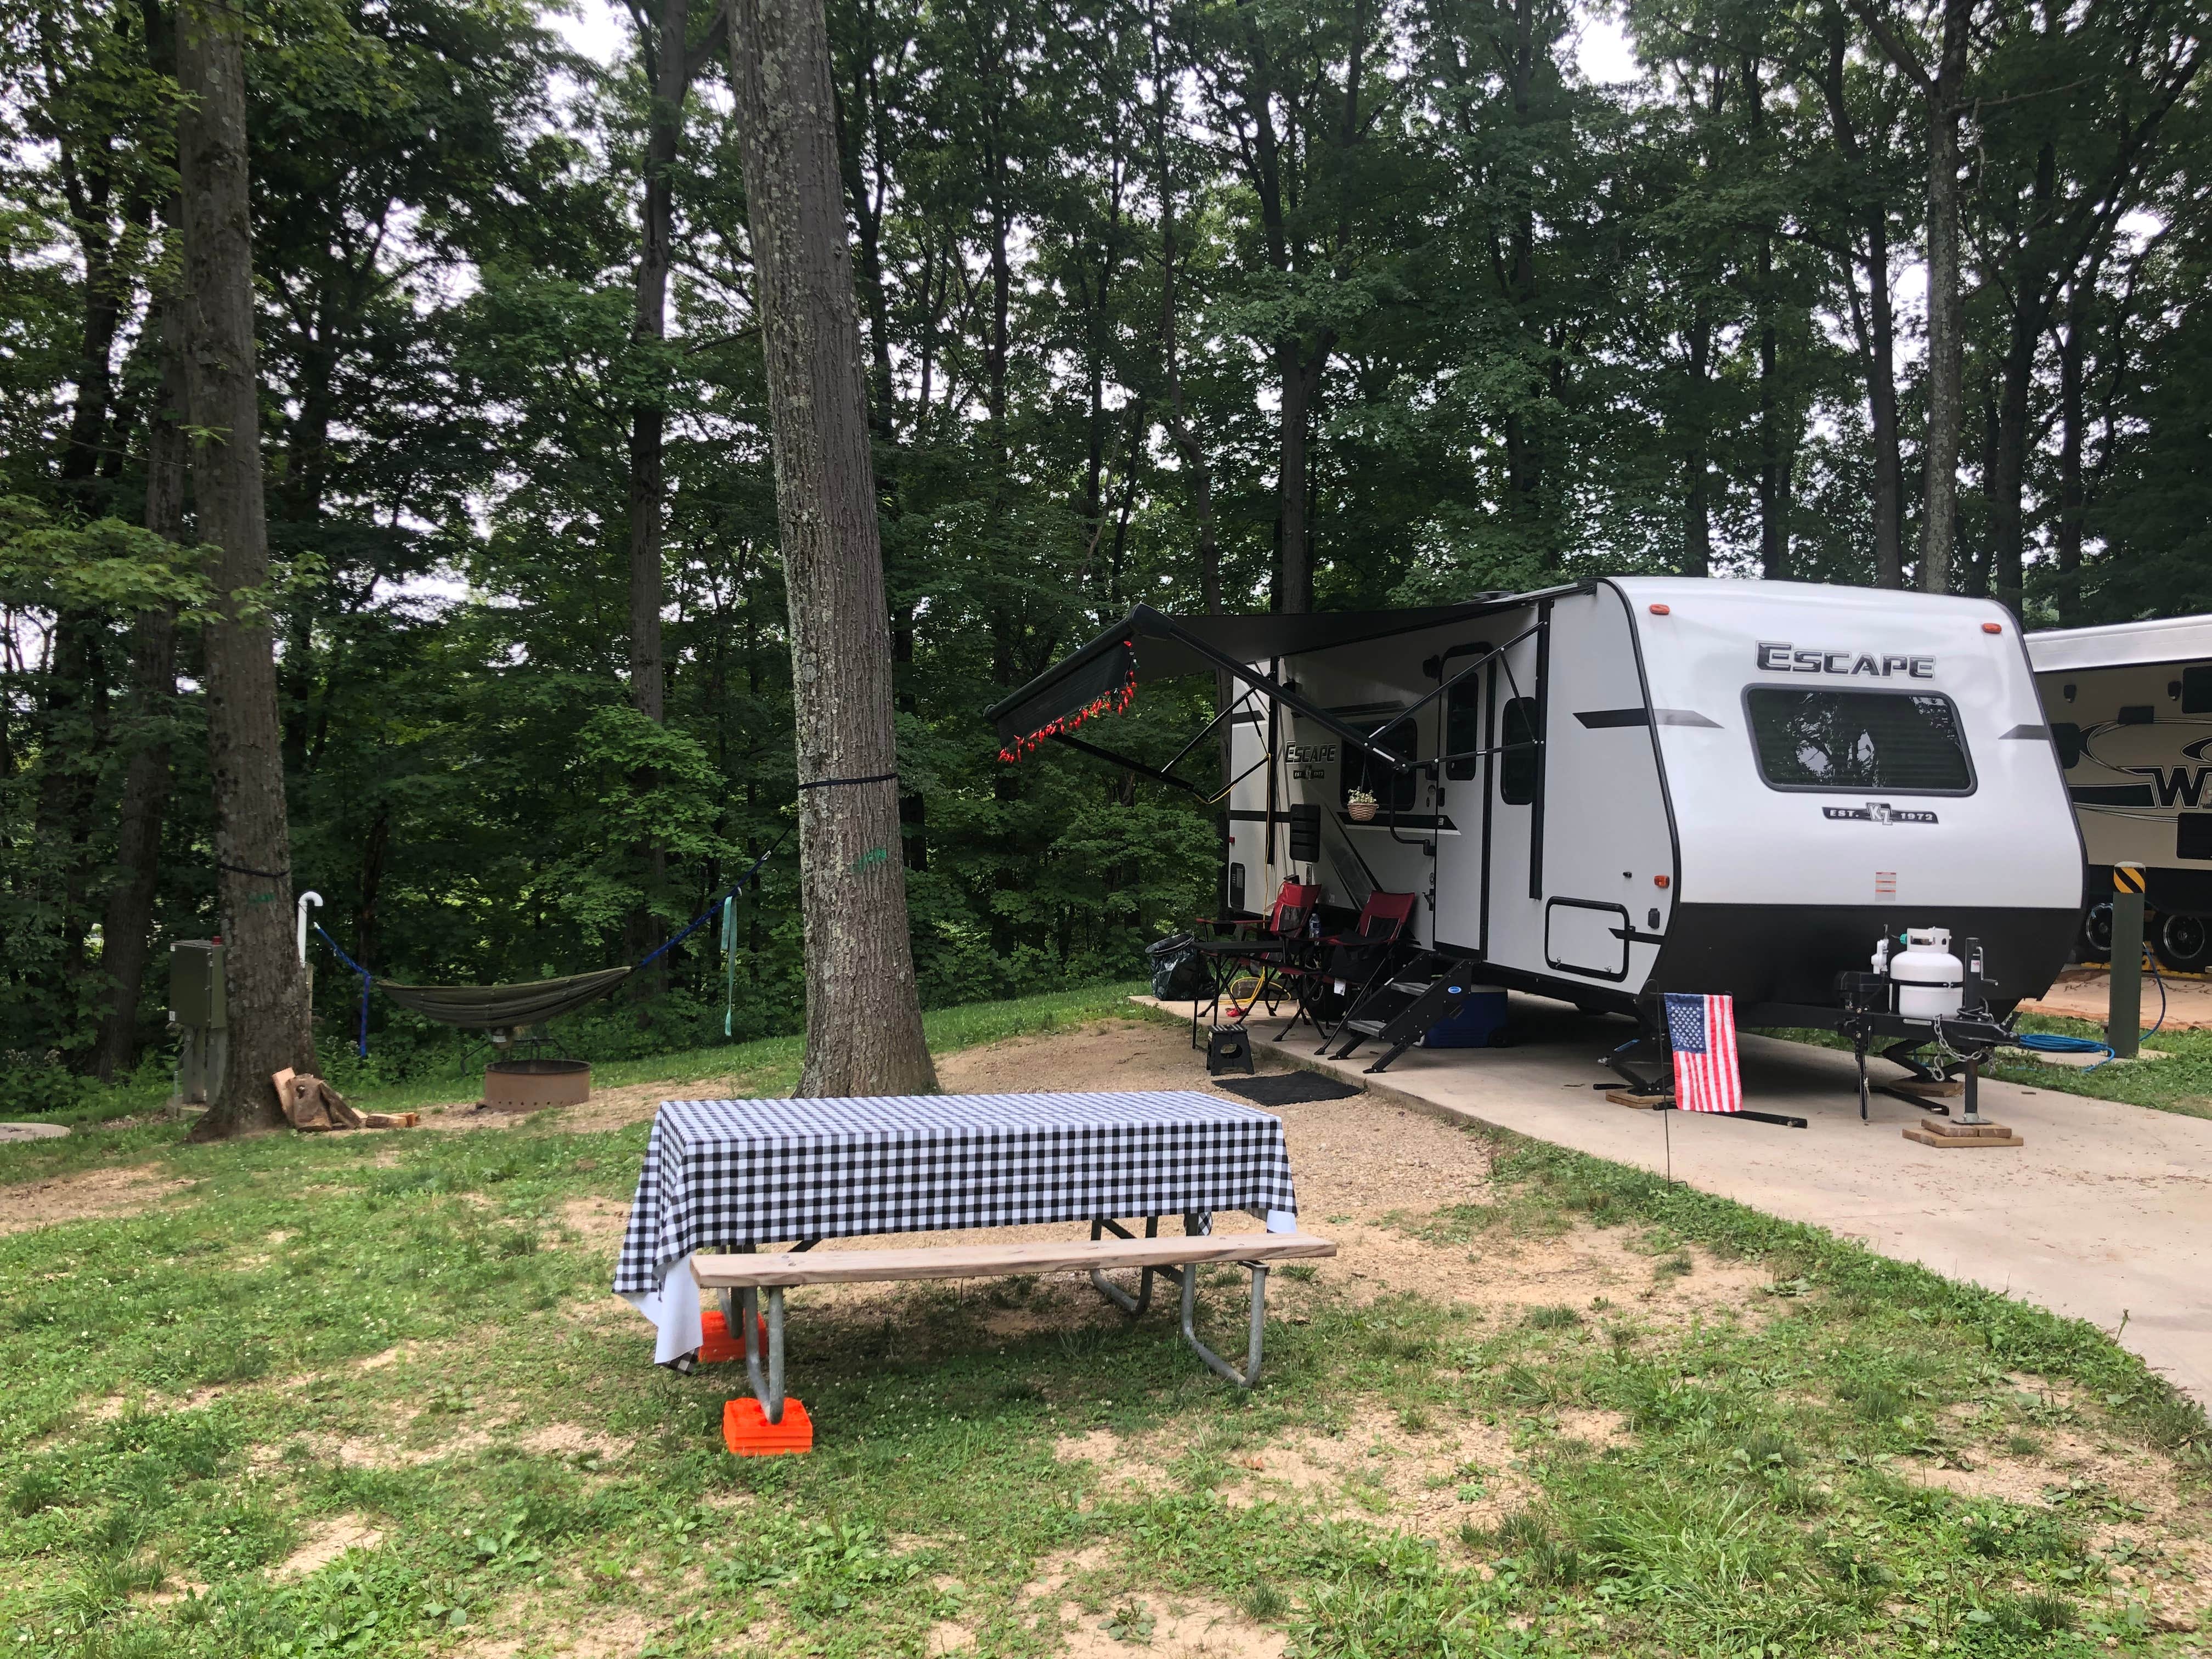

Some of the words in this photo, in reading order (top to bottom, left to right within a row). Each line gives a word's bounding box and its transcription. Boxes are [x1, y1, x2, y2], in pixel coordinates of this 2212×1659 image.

[1756, 641, 1934, 679] ESCAPE
[1285, 741, 1336, 763] ESCAPE
[1867, 803, 1893, 825] KZ
[1900, 812, 1933, 821] 1972
